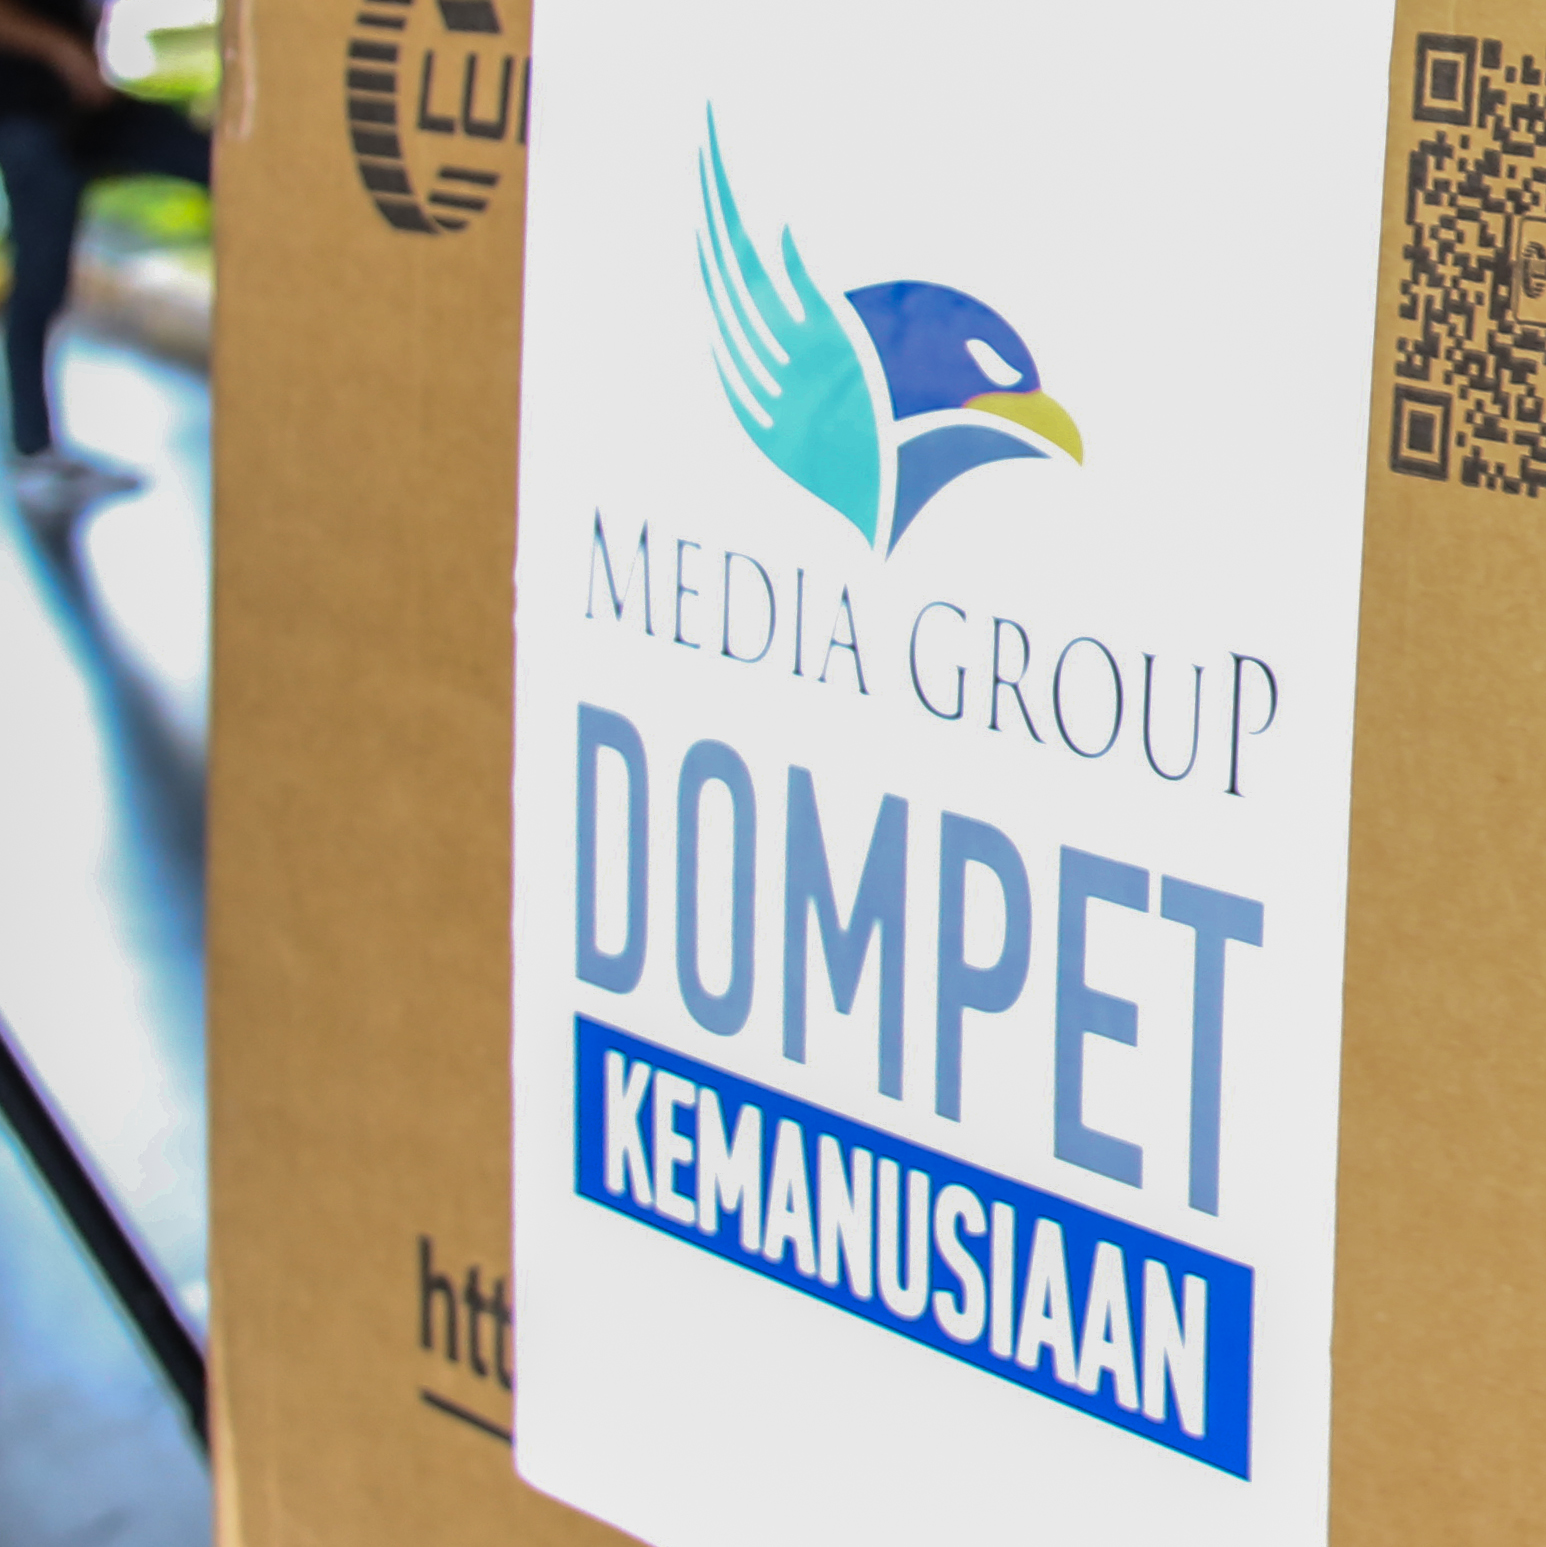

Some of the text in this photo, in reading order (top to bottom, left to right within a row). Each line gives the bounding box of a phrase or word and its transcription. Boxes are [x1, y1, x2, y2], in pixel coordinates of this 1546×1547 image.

[585, 506, 1279, 798] MEDIA GROUP
[575, 701, 1264, 1217] DOMPET
[604, 1049, 1208, 1438] KEMANUSIAAN
